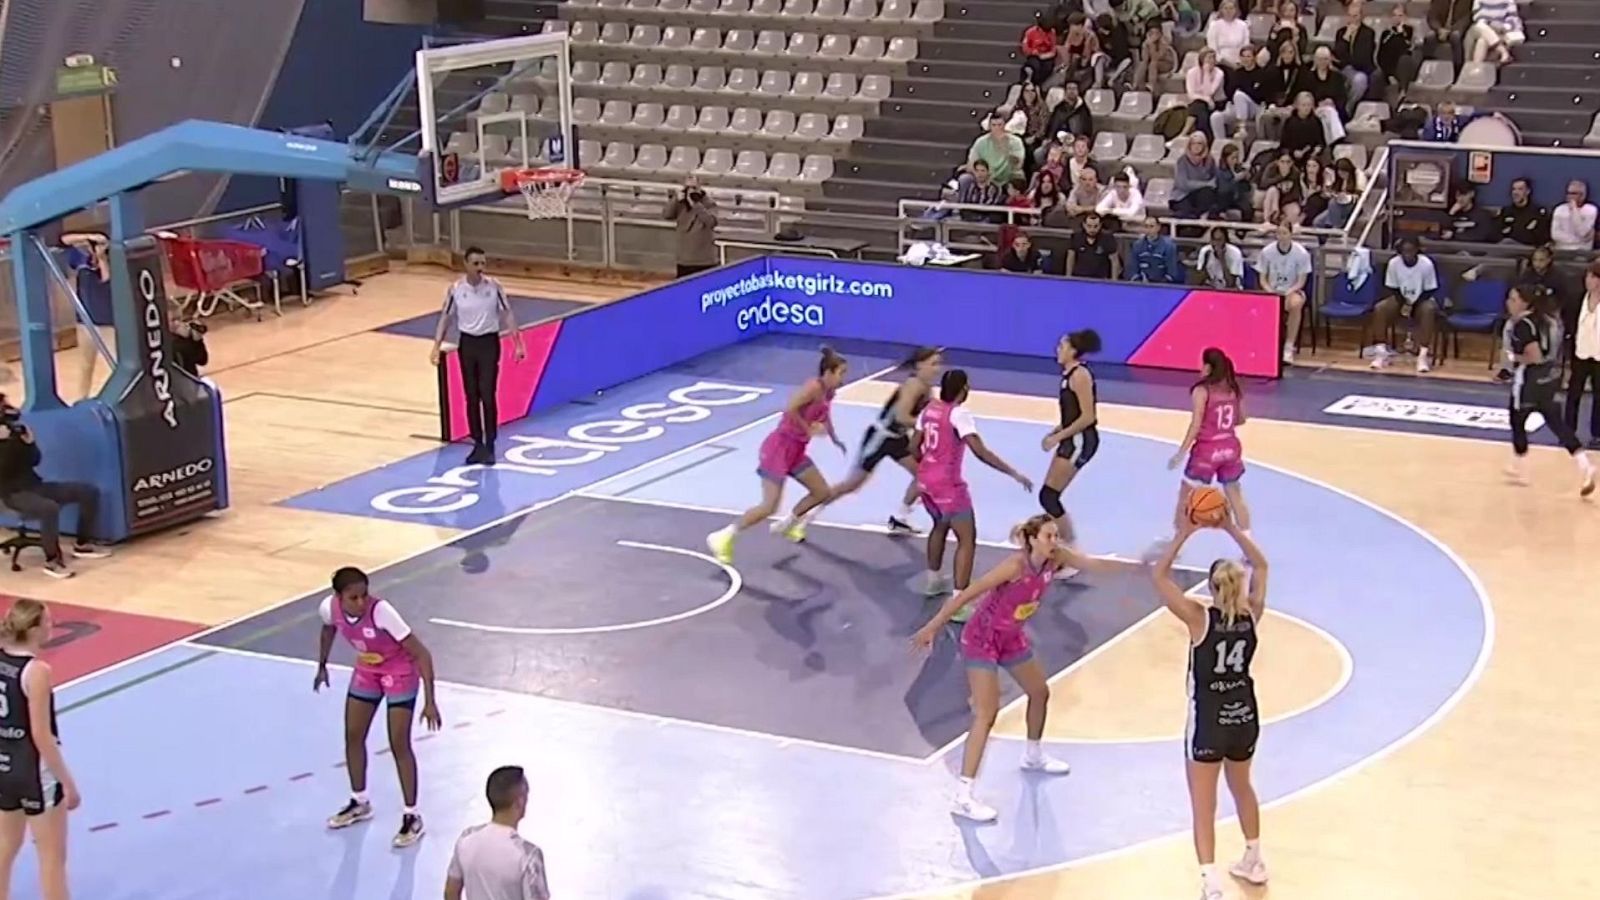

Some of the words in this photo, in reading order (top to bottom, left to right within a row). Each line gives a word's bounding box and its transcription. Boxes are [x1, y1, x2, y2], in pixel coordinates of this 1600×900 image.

[702, 271, 893, 313] proyectobasketgirlz.com
[737, 295, 825, 330] endesa
[140, 269, 178, 428] ARNEDO
[1215, 404, 1234, 430] 13
[370, 381, 773, 515] endesa
[924, 421, 940, 450] 15
[133, 458, 213, 492] ARNEDO
[1213, 639, 1248, 674] 14
